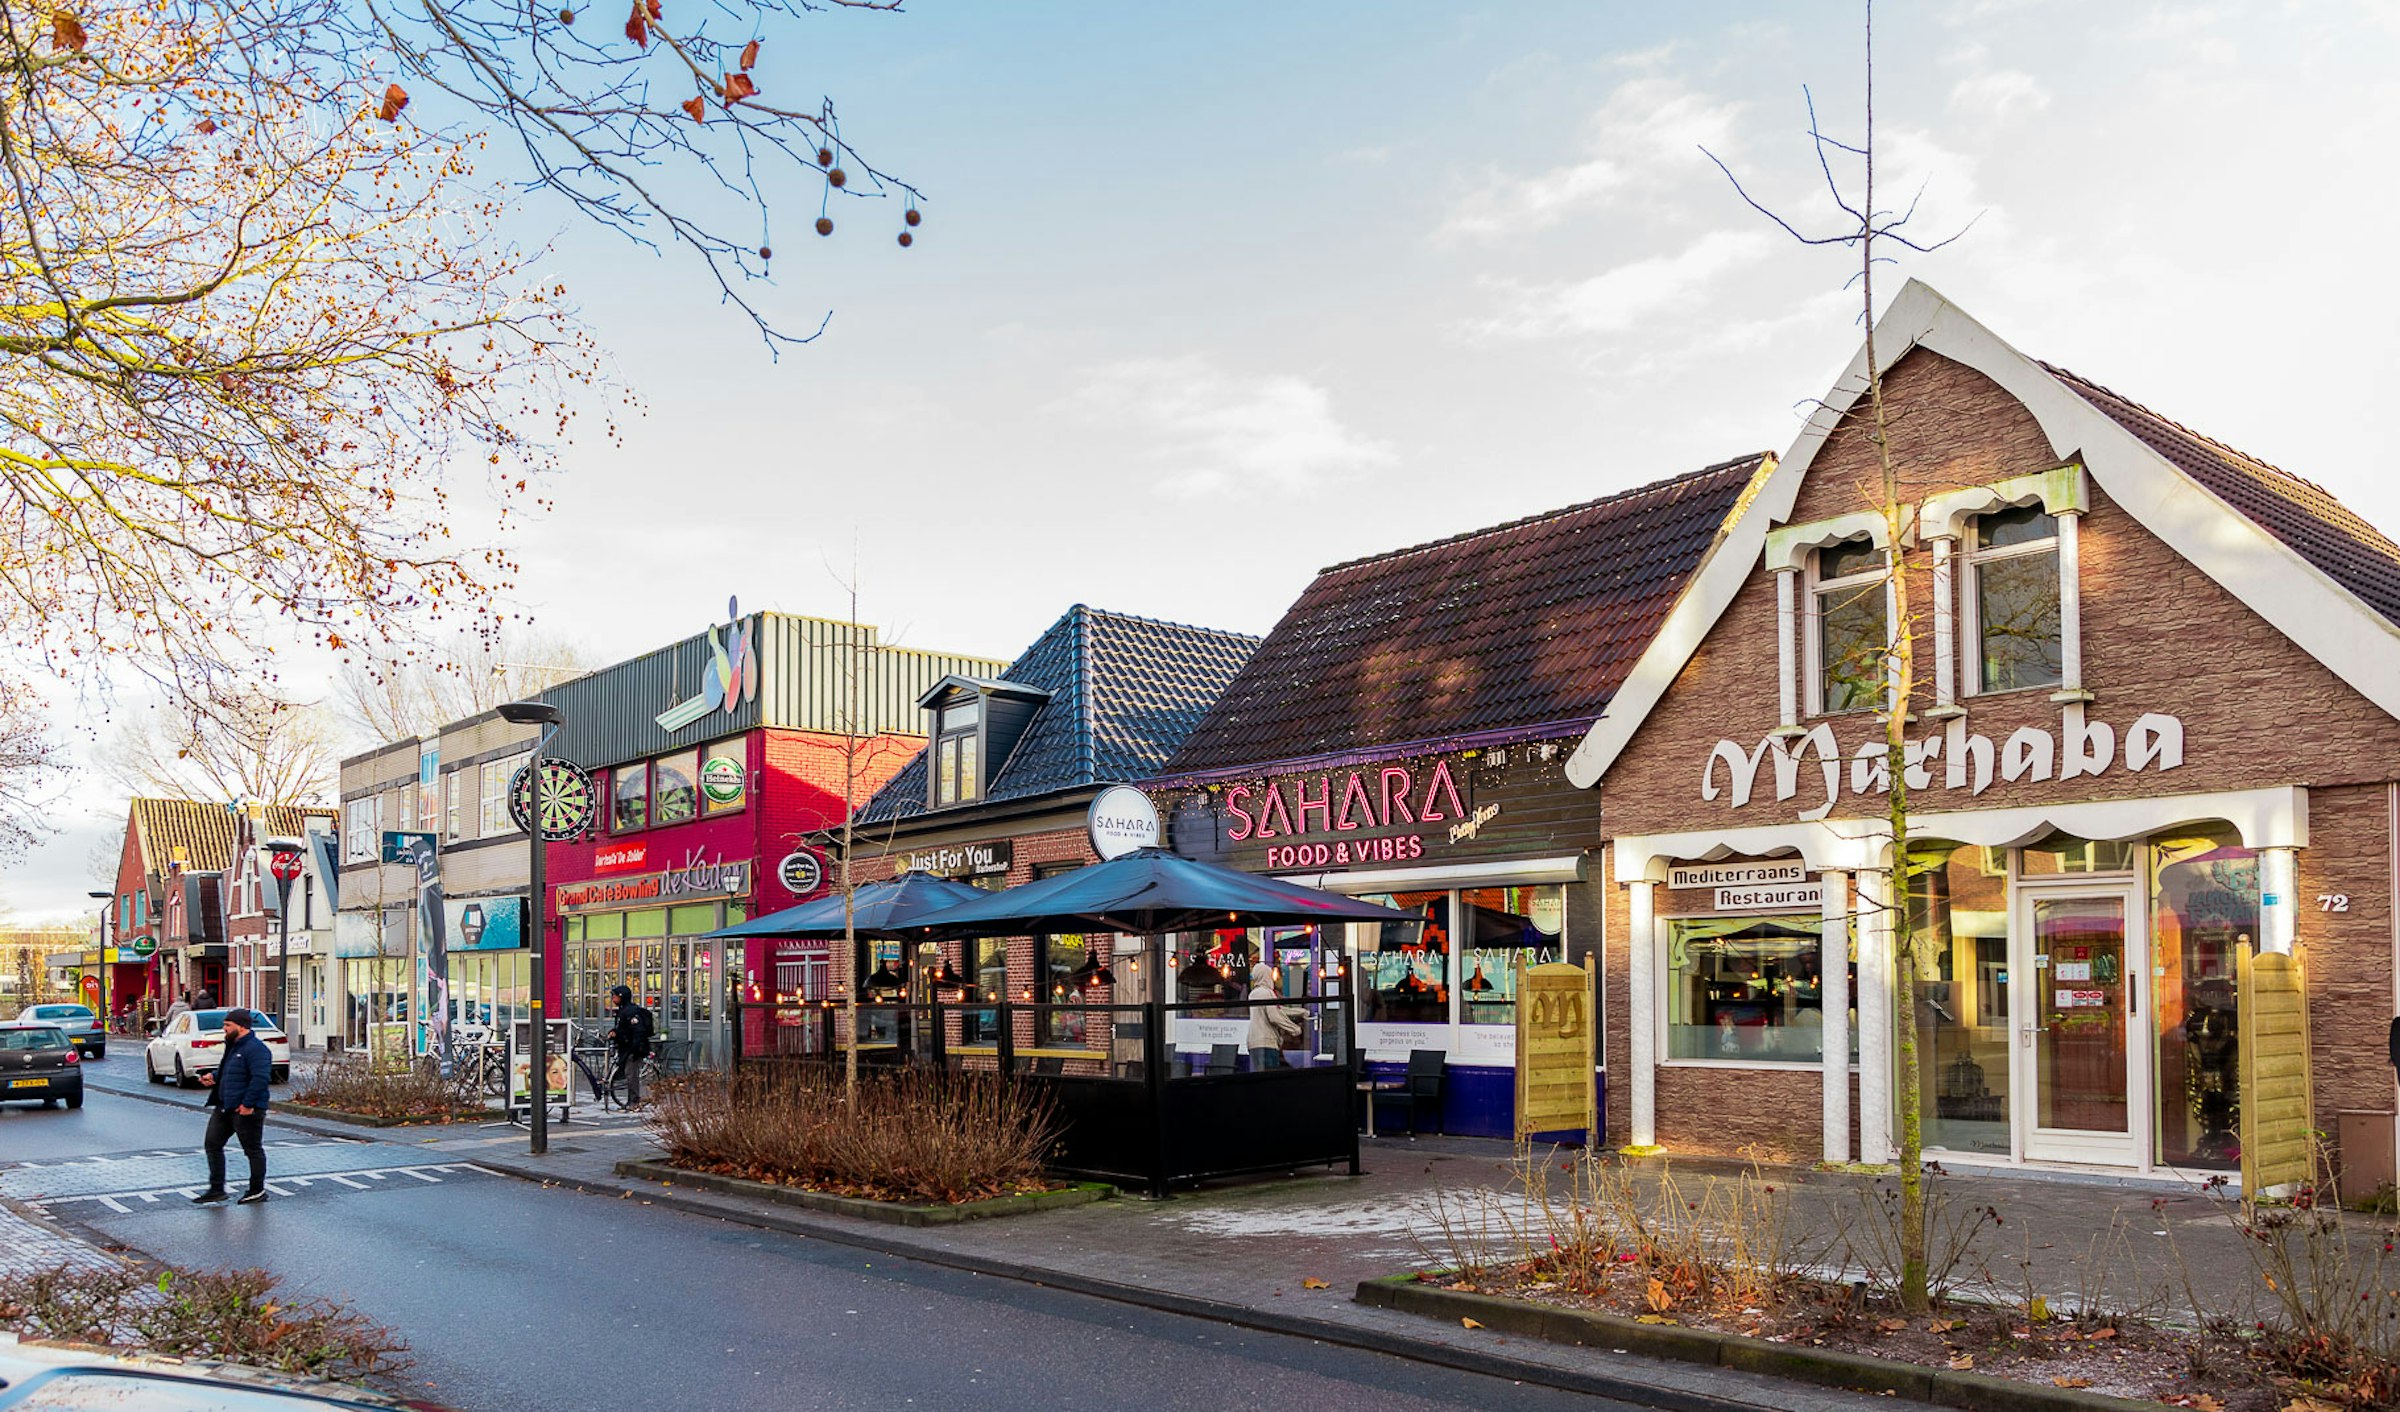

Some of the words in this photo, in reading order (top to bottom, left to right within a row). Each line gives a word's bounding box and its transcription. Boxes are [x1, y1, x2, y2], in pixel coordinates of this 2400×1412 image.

[1702, 711, 2185, 822] Marhaba
[1227, 759, 1466, 841] SAHARA
[1096, 815, 1155, 831] SAHARA
[907, 852, 939, 870] Just
[940, 849, 963, 869] For
[965, 846, 993, 866] You
[1267, 842, 1330, 869] FOOD
[1336, 841, 1350, 864] &
[1354, 834, 1423, 861] VIBES
[560, 886, 589, 906] Grand
[615, 878, 660, 902] Bowling
[661, 860, 681, 895] de
[1674, 866, 1800, 885] Mediterraans
[2316, 894, 2350, 912] 72
[1189, 952, 1246, 968] SHARA
[1370, 949, 1440, 966] SAHARA
